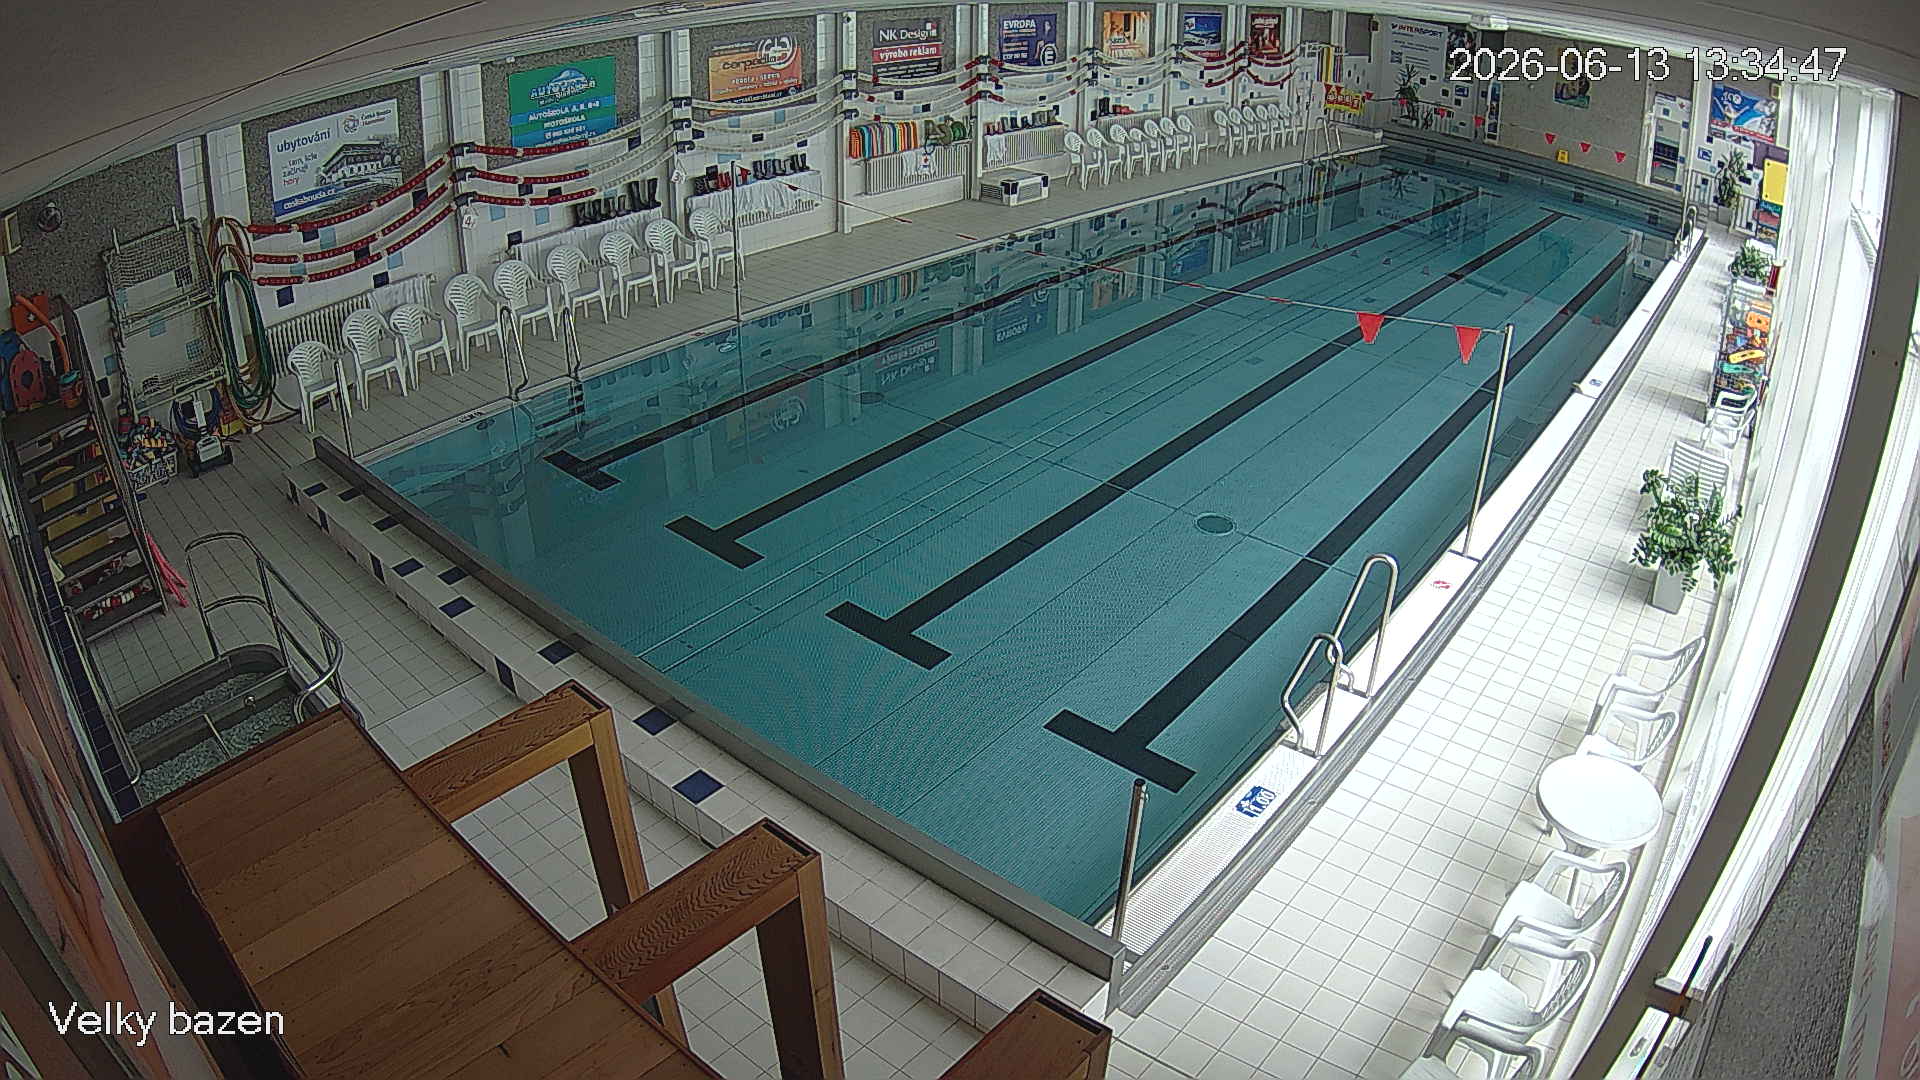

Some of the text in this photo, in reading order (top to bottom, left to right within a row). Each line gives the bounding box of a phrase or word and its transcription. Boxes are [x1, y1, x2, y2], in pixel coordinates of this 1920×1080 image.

[1003, 19, 1036, 29] EVROPA
[880, 29, 898, 41] NK
[880, 46, 937, 61] výroba reklam
[276, 127, 331, 153] ubytování
